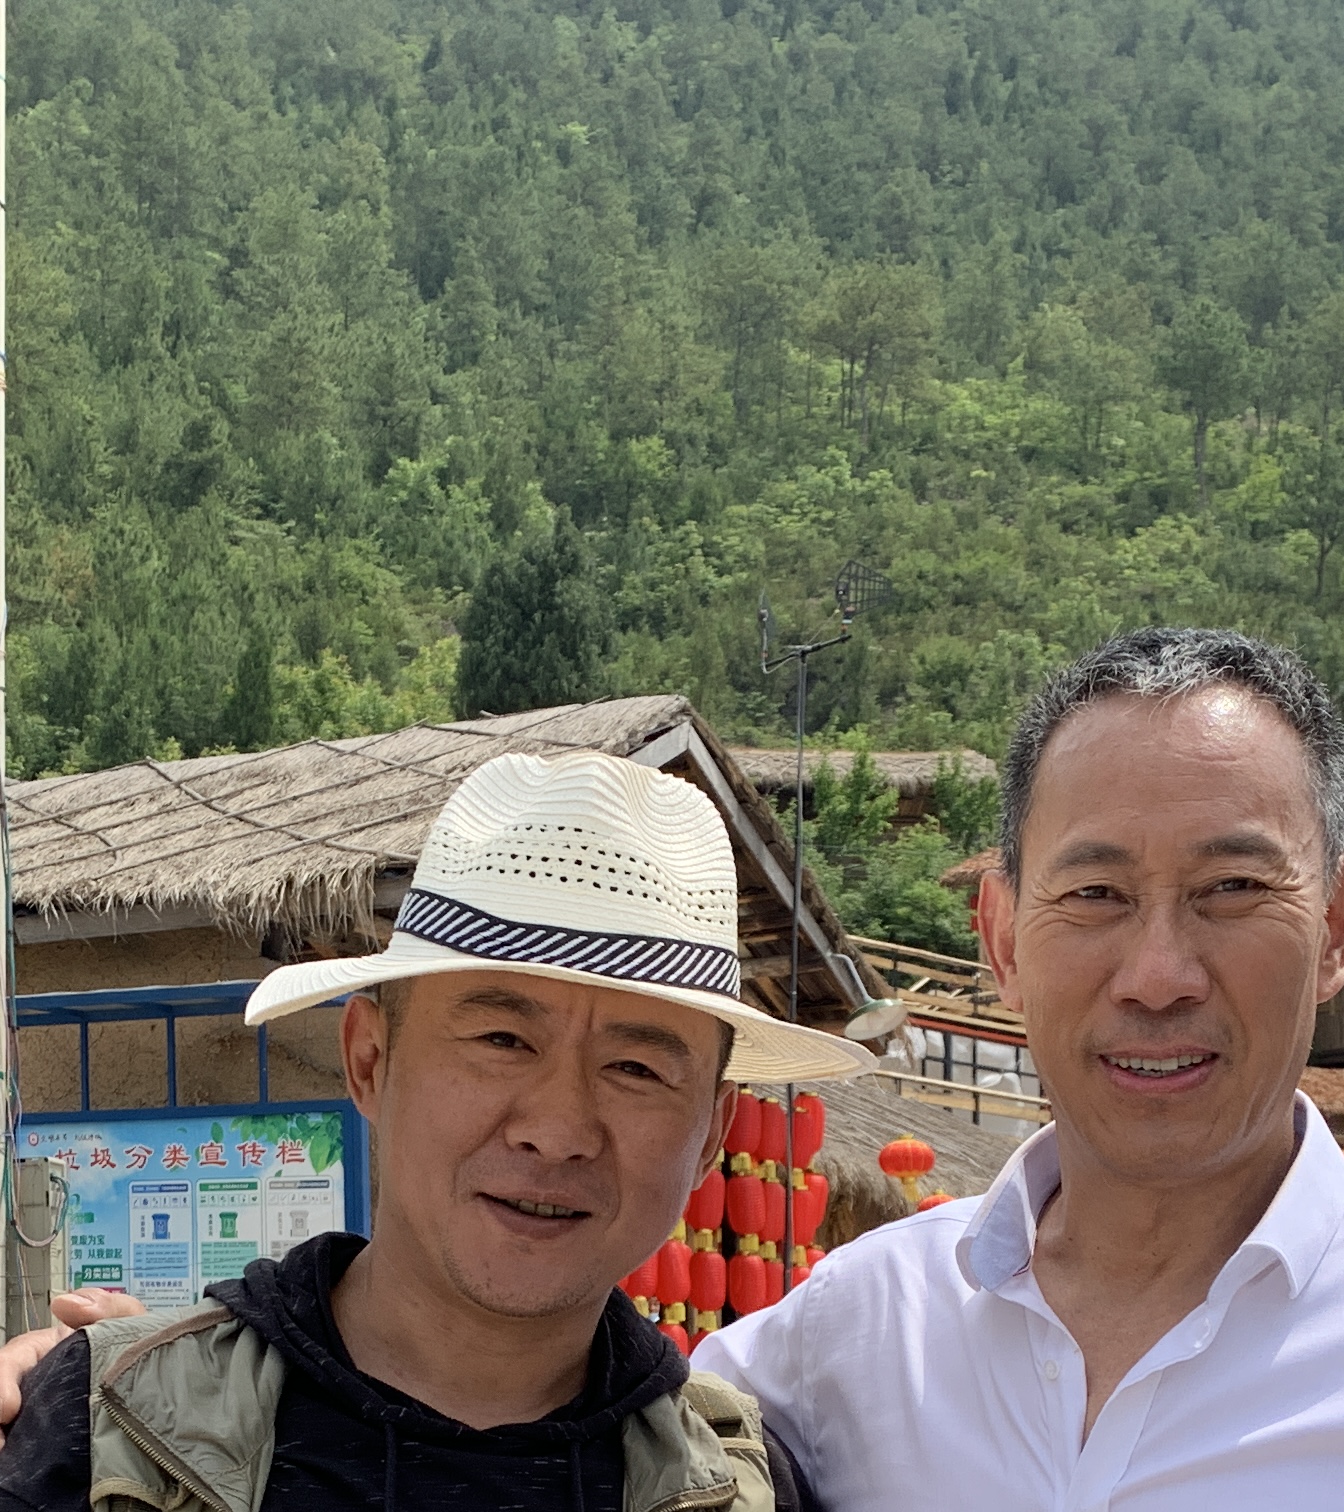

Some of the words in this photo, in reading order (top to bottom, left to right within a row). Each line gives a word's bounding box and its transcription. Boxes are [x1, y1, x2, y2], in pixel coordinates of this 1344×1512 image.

[54, 1139, 306, 1172] 垃圾分类宣传栏
